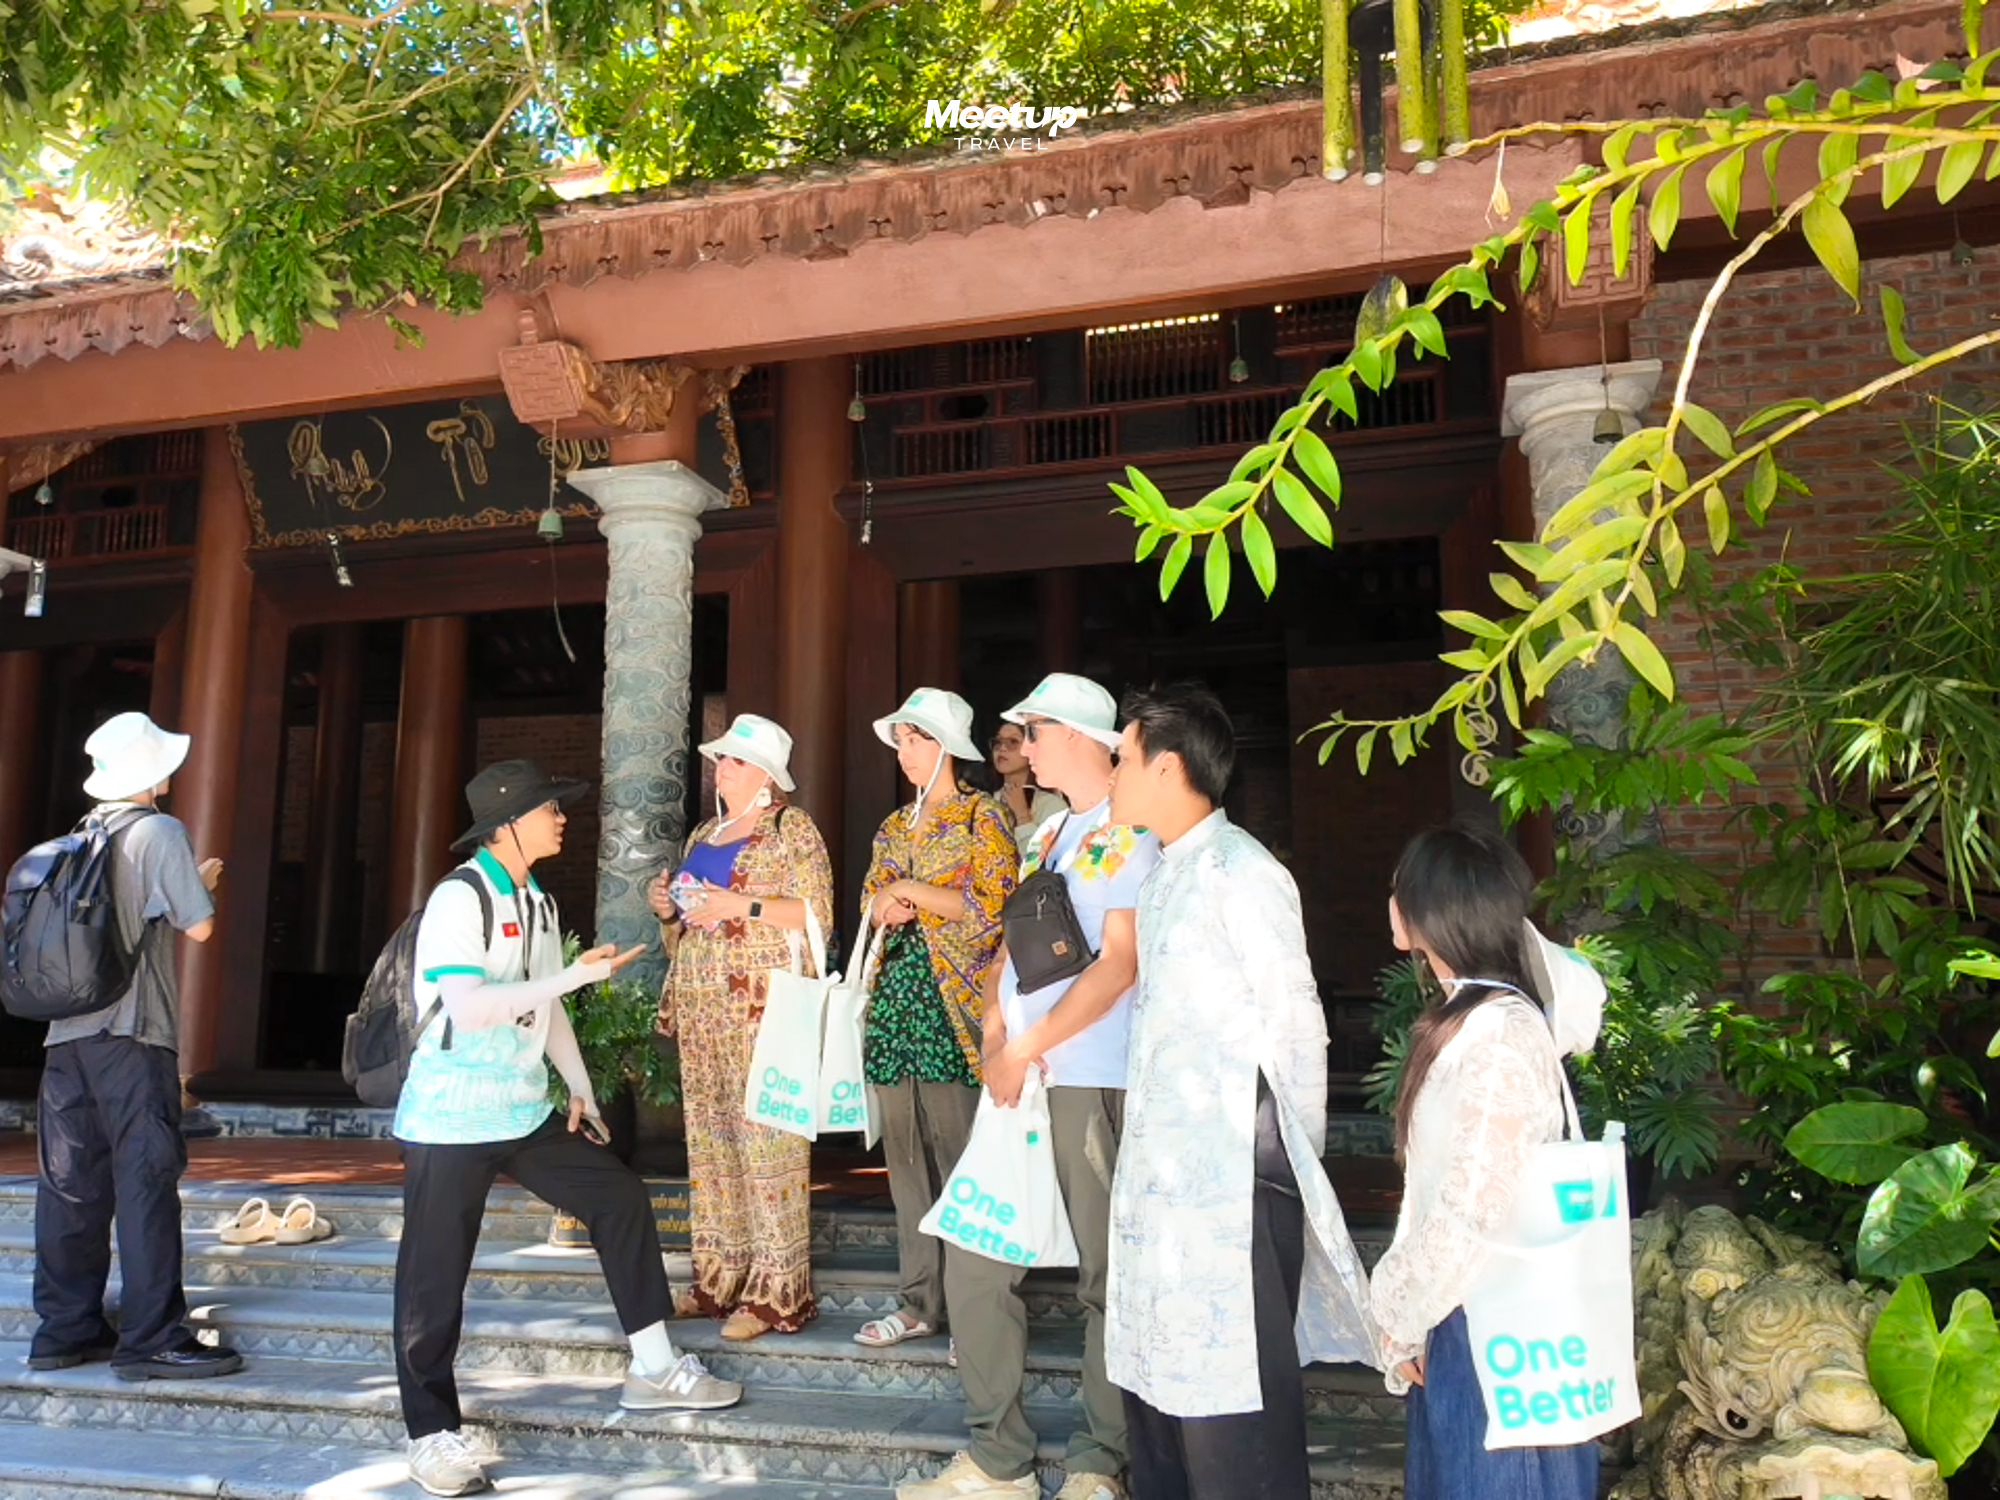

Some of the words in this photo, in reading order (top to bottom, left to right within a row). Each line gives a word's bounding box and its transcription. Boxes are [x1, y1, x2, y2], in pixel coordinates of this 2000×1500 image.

[763, 1066, 801, 1096] One
[950, 1176, 1017, 1225] One
[938, 1204, 1037, 1267] Better
[1486, 1334, 1588, 1378] One
[1494, 1376, 1617, 1429] Better
